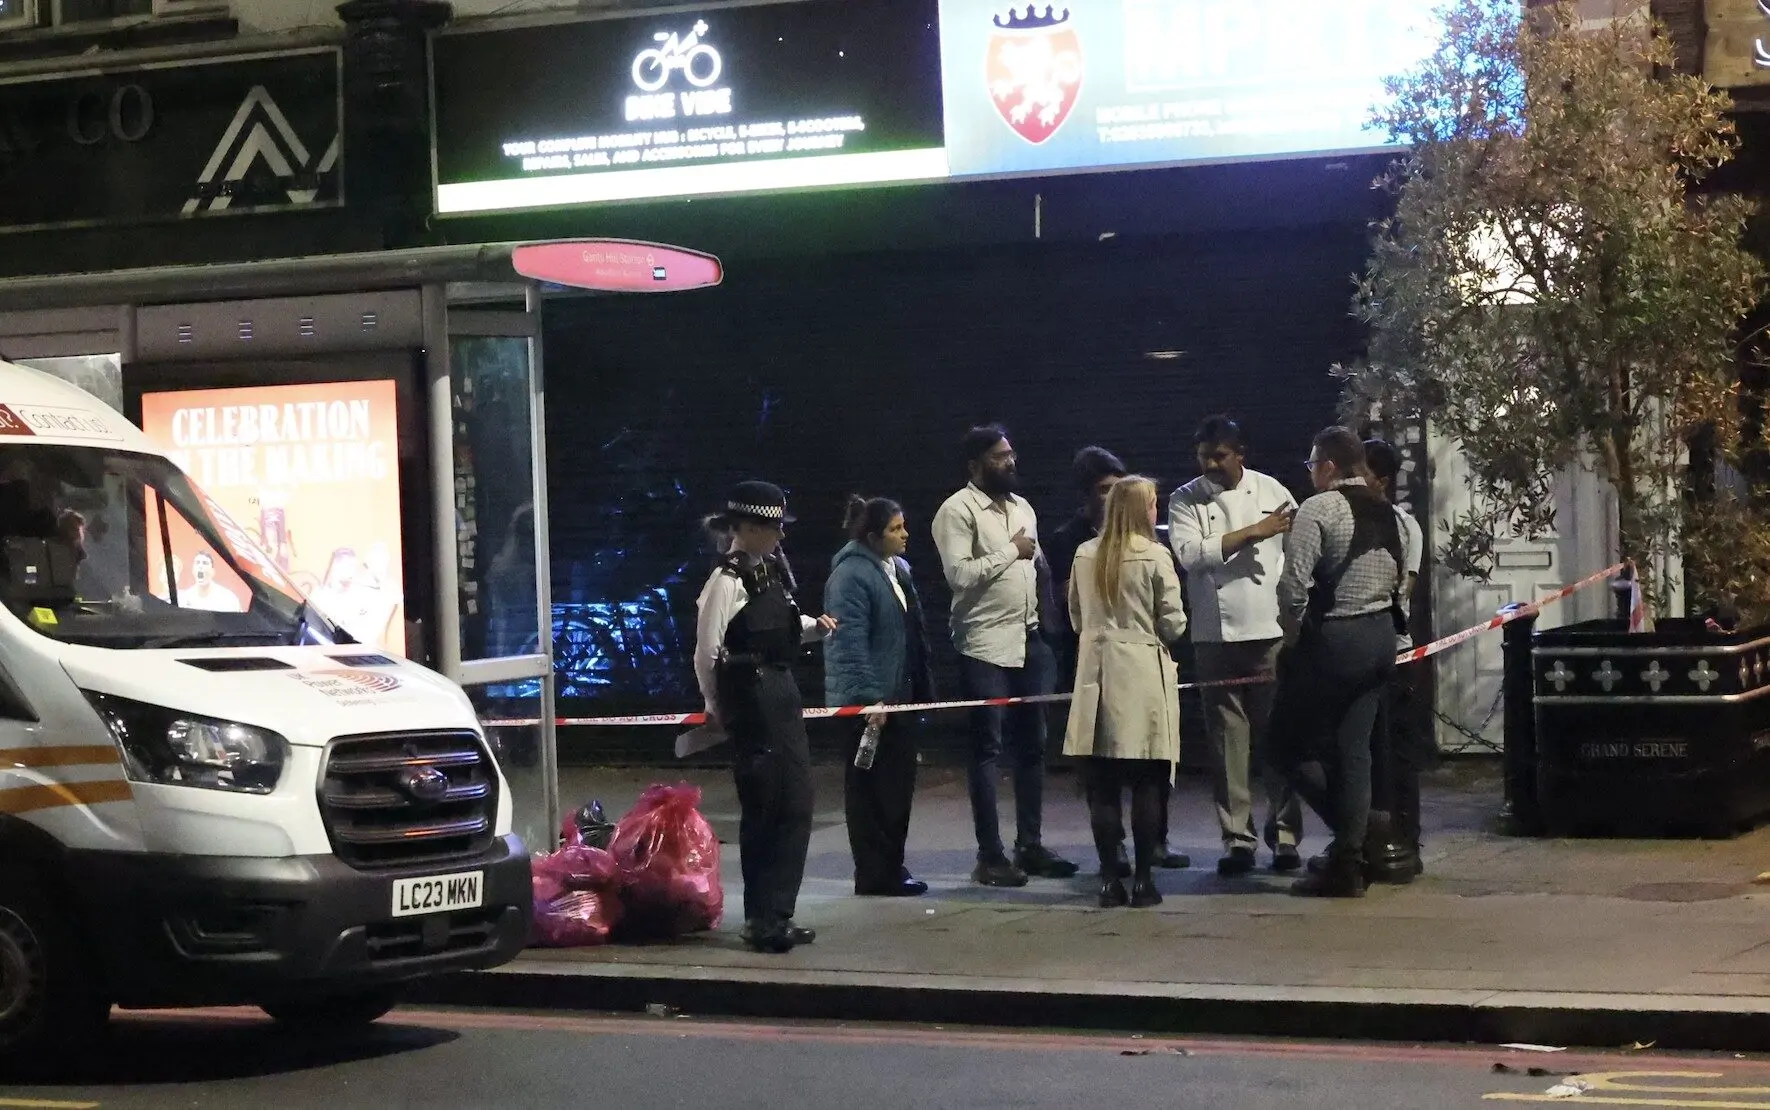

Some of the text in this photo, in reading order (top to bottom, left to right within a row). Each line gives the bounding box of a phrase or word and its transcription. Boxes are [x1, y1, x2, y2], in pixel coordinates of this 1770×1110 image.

[626, 88, 731, 121] BIKE VIBE
[172, 400, 370, 447] CELEBRATION
[197, 446, 257, 488] THE
[264, 440, 388, 484] MAKING
[1581, 742, 1689, 759] GRAND SERENE
[400, 875, 478, 911] LC23 MKN
